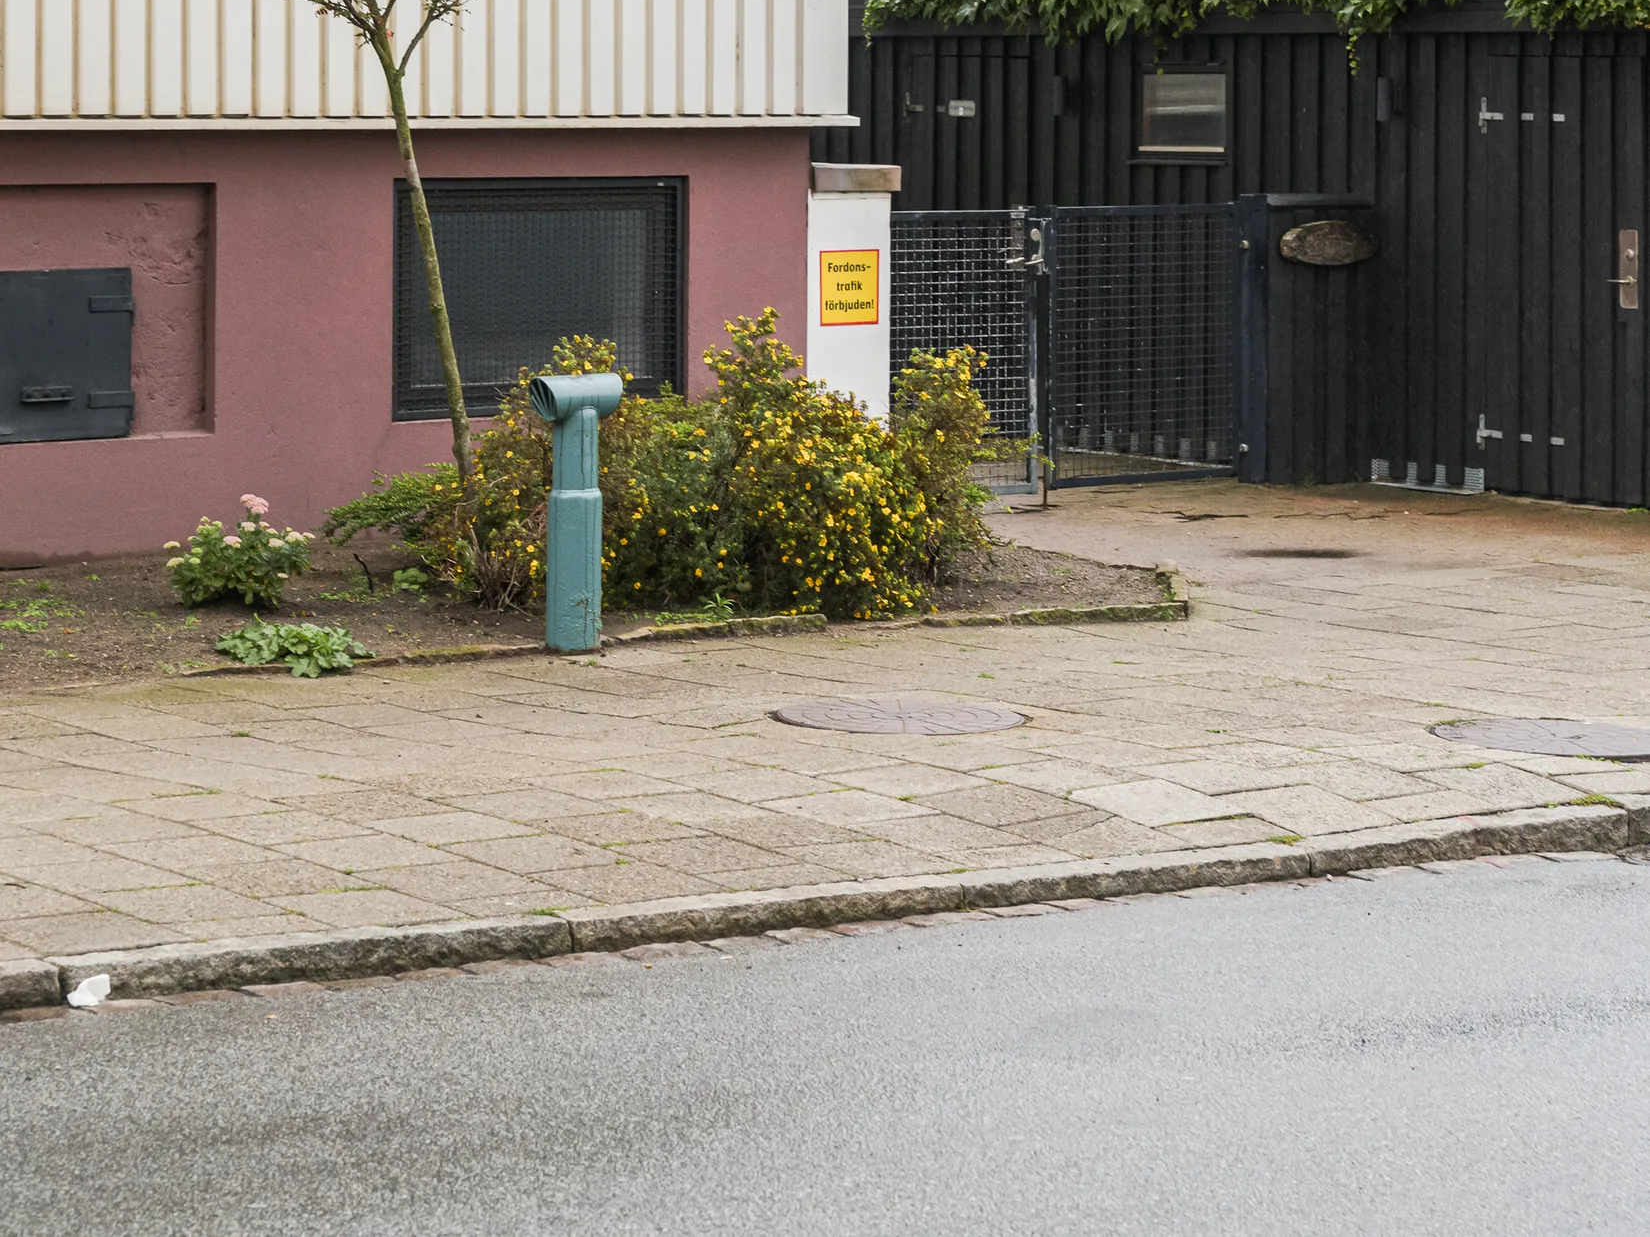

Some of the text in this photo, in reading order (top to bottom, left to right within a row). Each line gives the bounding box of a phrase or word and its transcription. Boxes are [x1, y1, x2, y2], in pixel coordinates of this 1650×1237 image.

[828, 262, 871, 273] Fordons-
[836, 280, 863, 291] trafik
[825, 299, 874, 312] förbjuden!
